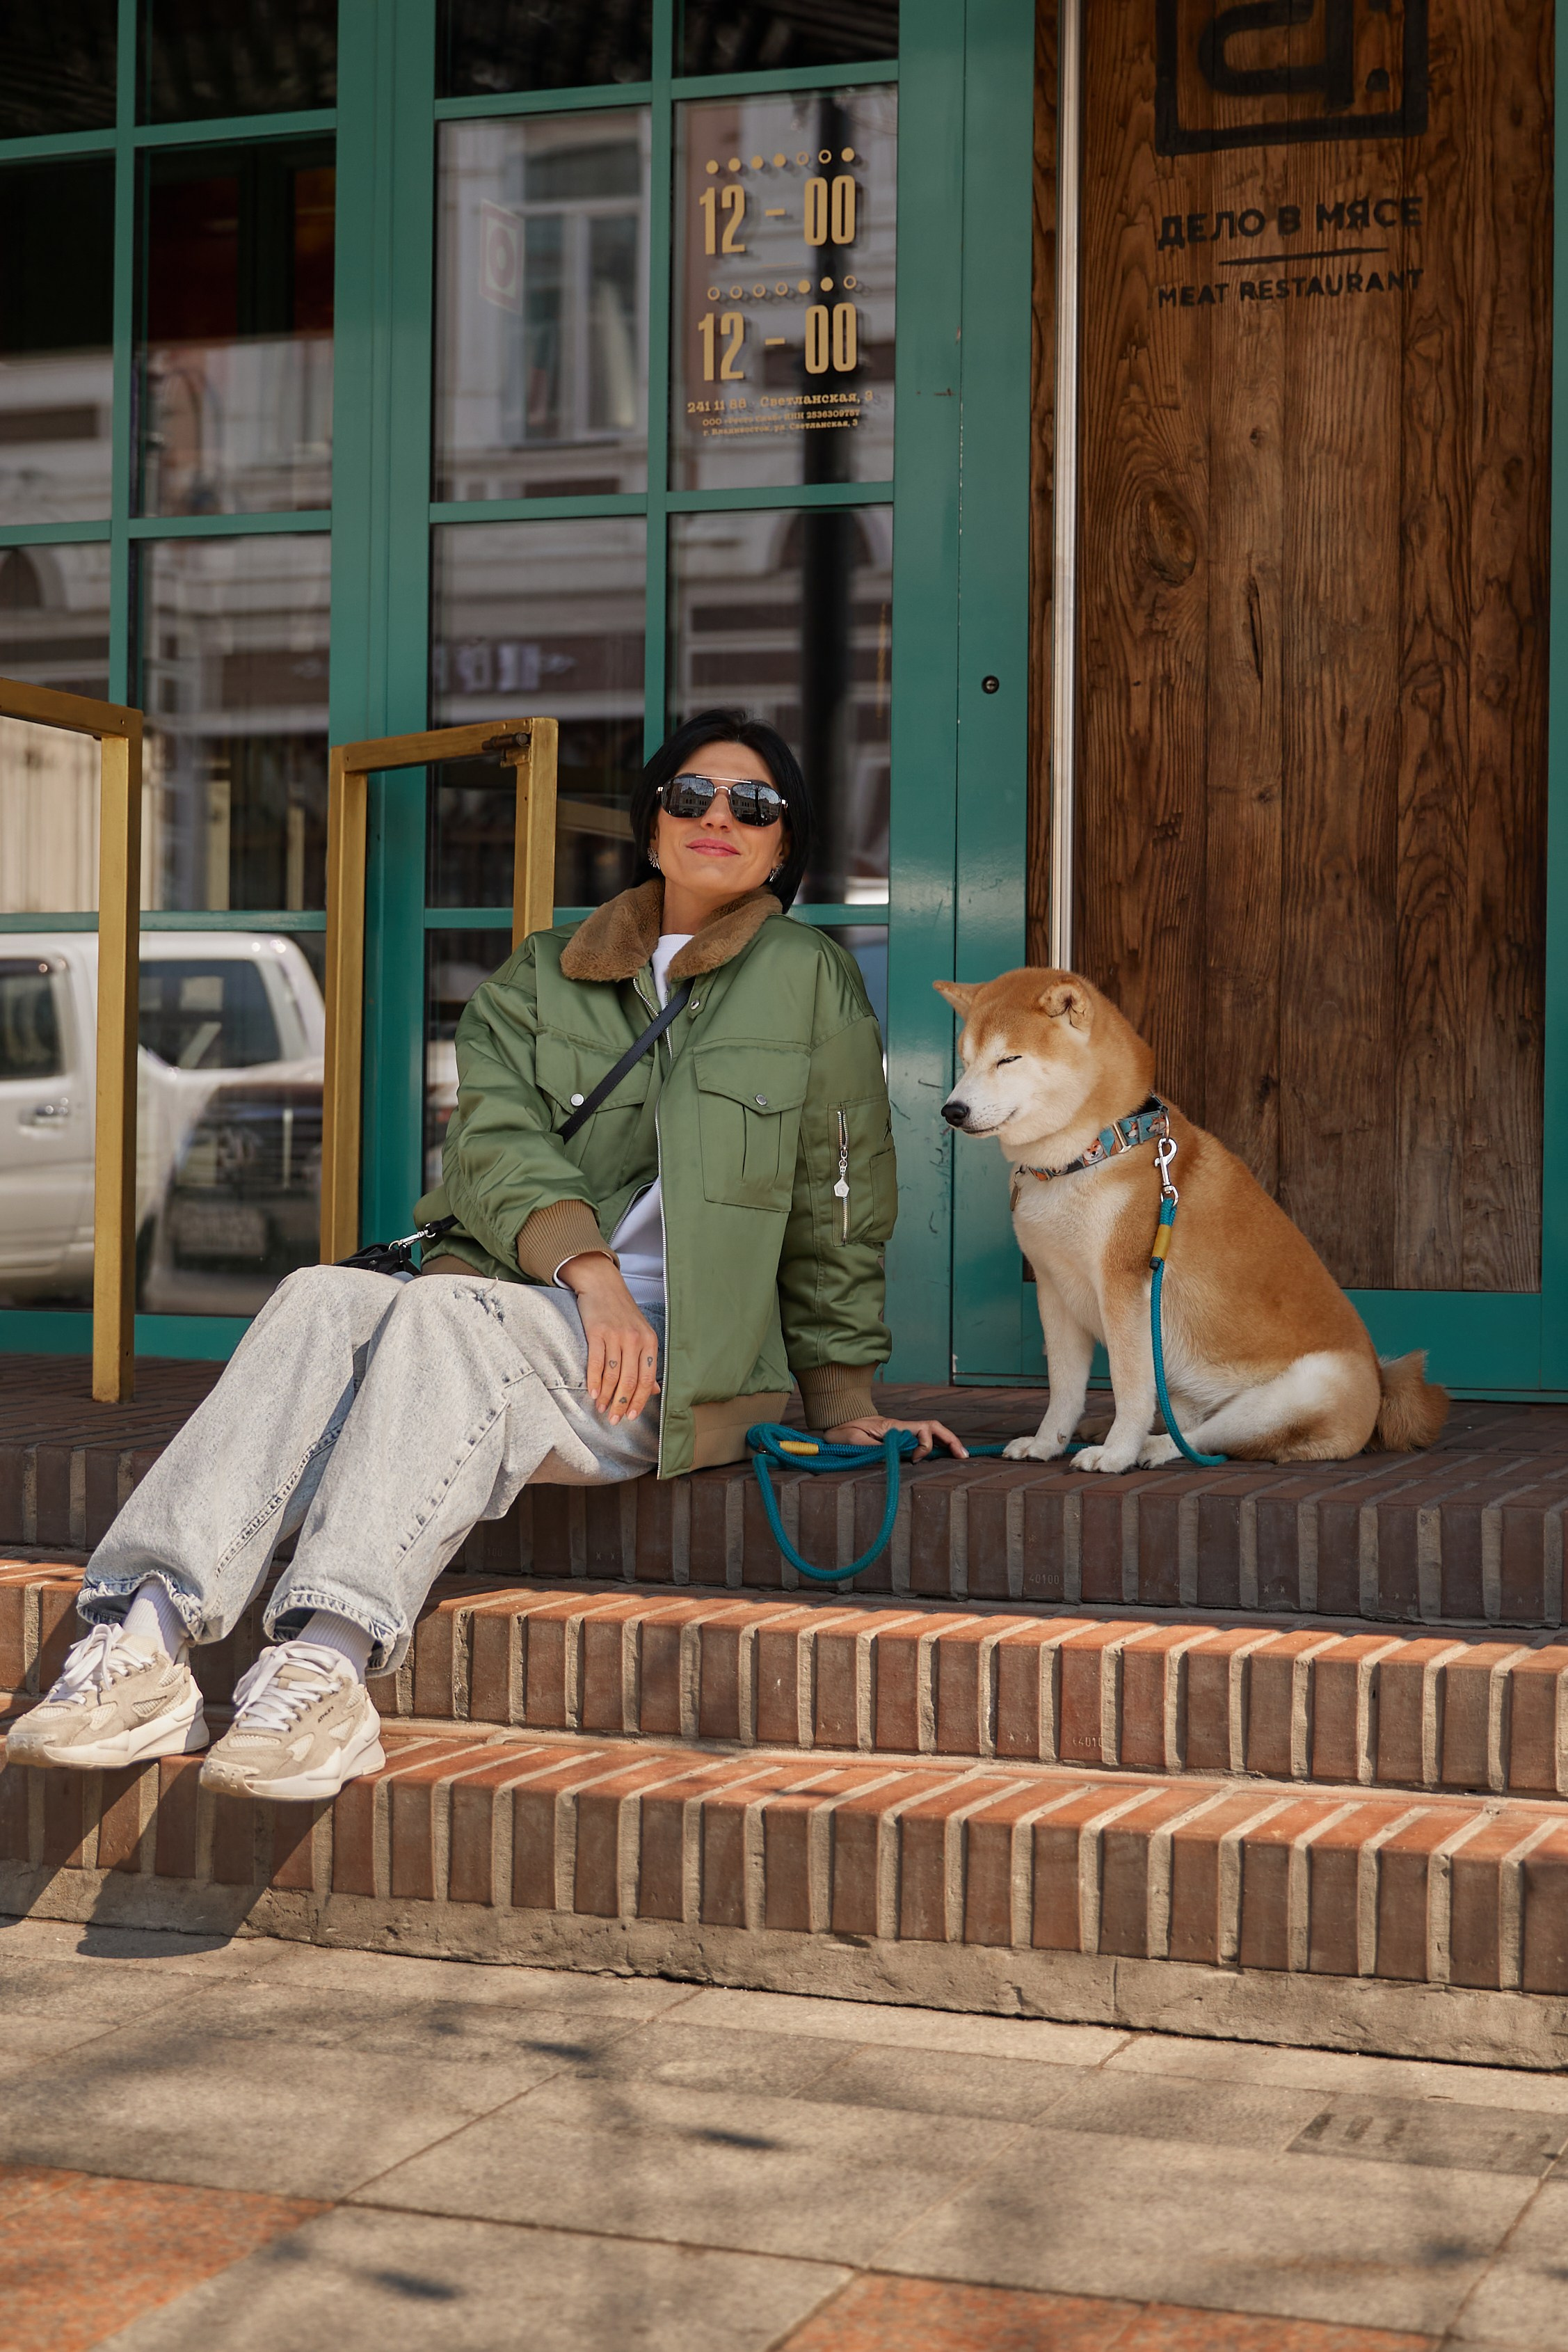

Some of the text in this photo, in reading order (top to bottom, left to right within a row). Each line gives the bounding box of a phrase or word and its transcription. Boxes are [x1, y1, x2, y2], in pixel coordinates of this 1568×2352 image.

[699, 184, 746, 255] 12
[804, 175, 856, 246] 00
[1158, 196, 1423, 251] ДЕЛО В МЯСЕ
[1158, 268, 1424, 308] MEAT RESTAURANT
[698, 312, 744, 381] 12
[805, 302, 857, 374] 00
[687, 401, 710, 413] 241
[714, 400, 725, 411] 11
[729, 397, 747, 409] 88
[760, 392, 861, 407] Светланская,
